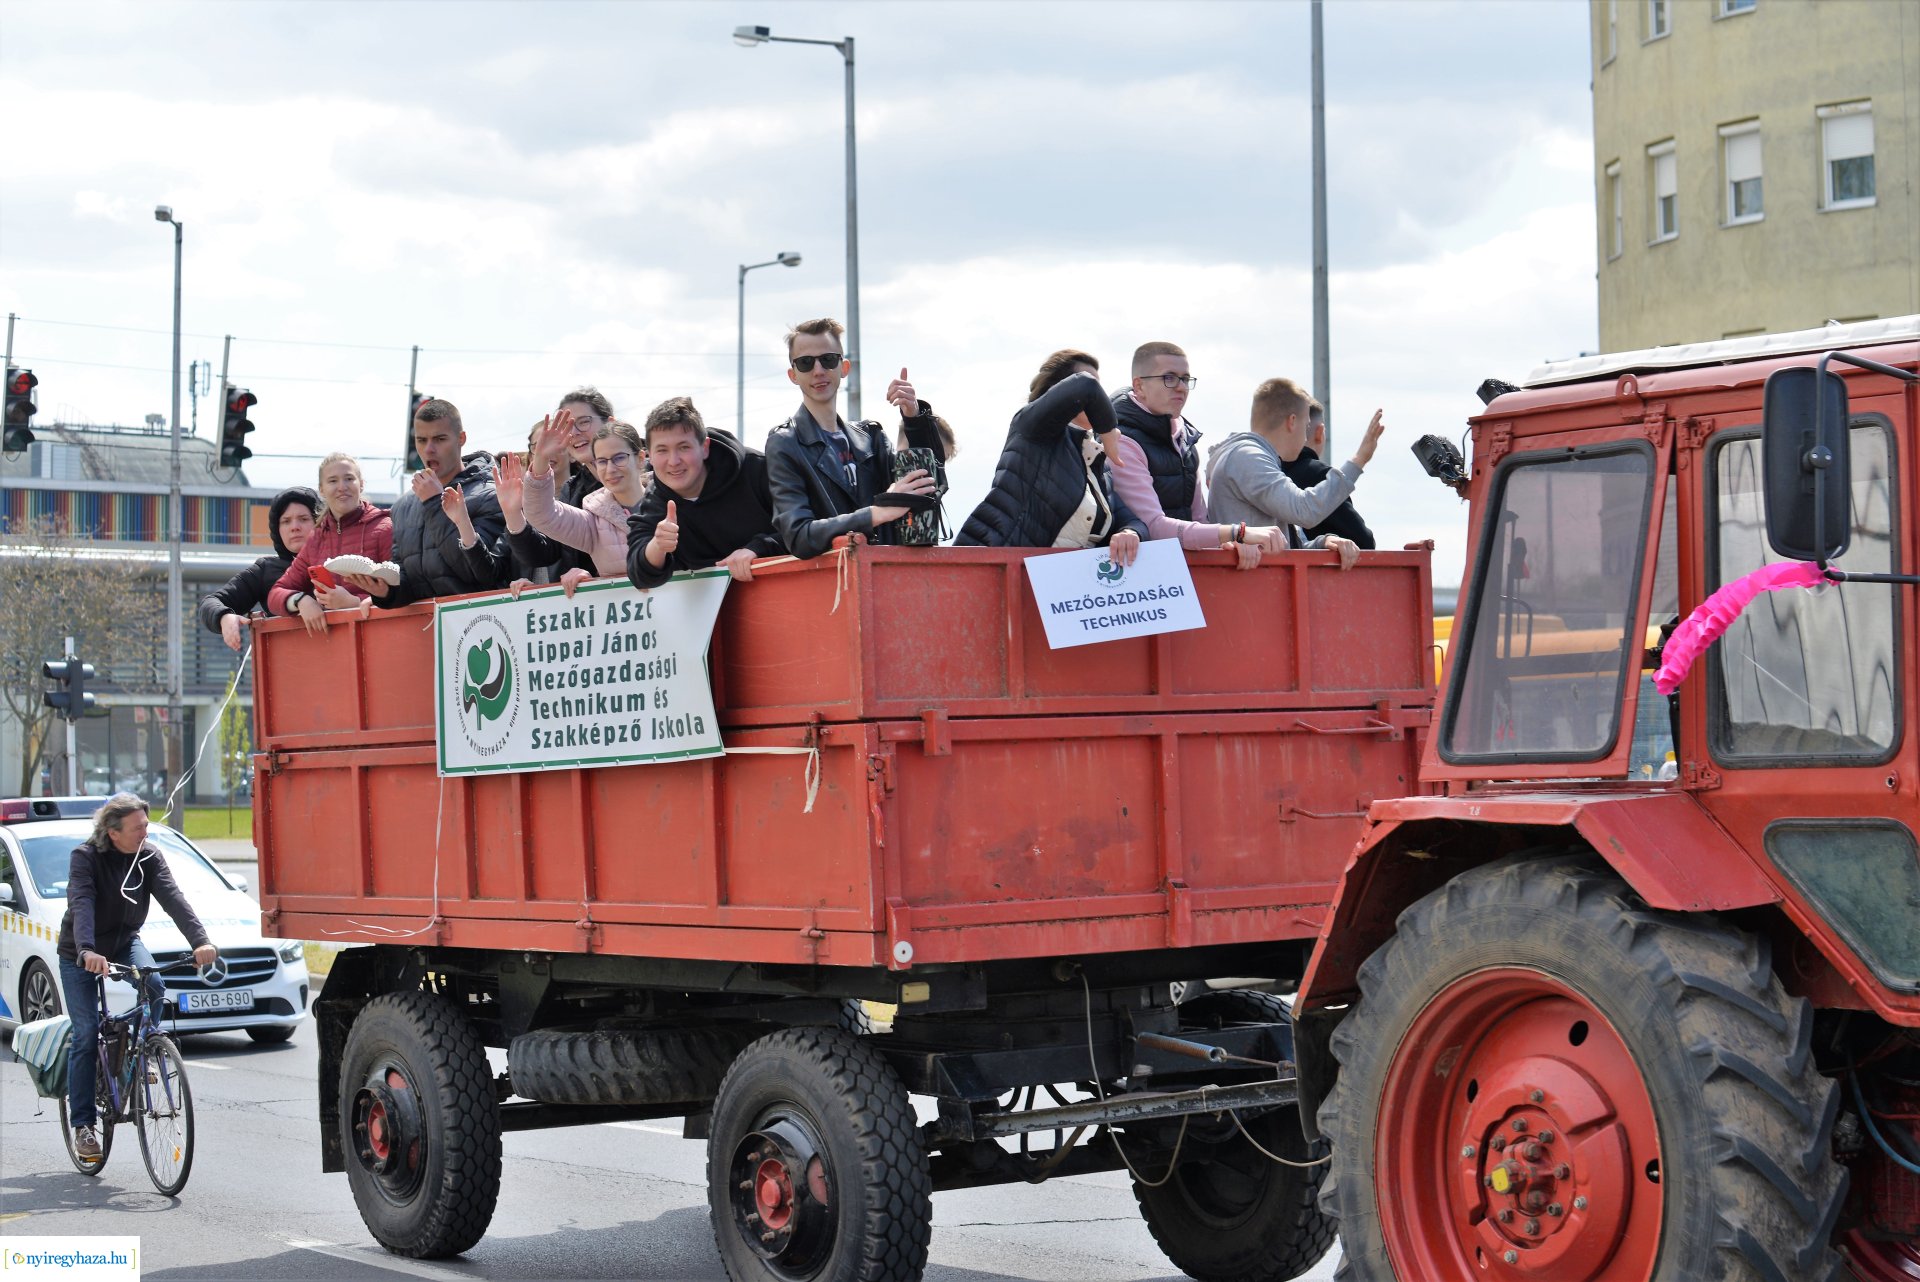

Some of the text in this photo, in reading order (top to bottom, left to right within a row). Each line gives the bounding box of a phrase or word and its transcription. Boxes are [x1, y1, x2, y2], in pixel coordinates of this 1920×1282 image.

[1050, 585, 1185, 615] MEZŐGAZDASÁGI
[526, 604, 595, 635] Északi
[1080, 608, 1168, 631] TECHNIKUS
[527, 629, 657, 664] Lippai János
[528, 652, 677, 692] Mezőgazdasági
[530, 687, 668, 721] Technikum és
[531, 712, 705, 749] Szakképző Iskola
[191, 992, 250, 1008] SKB-690
